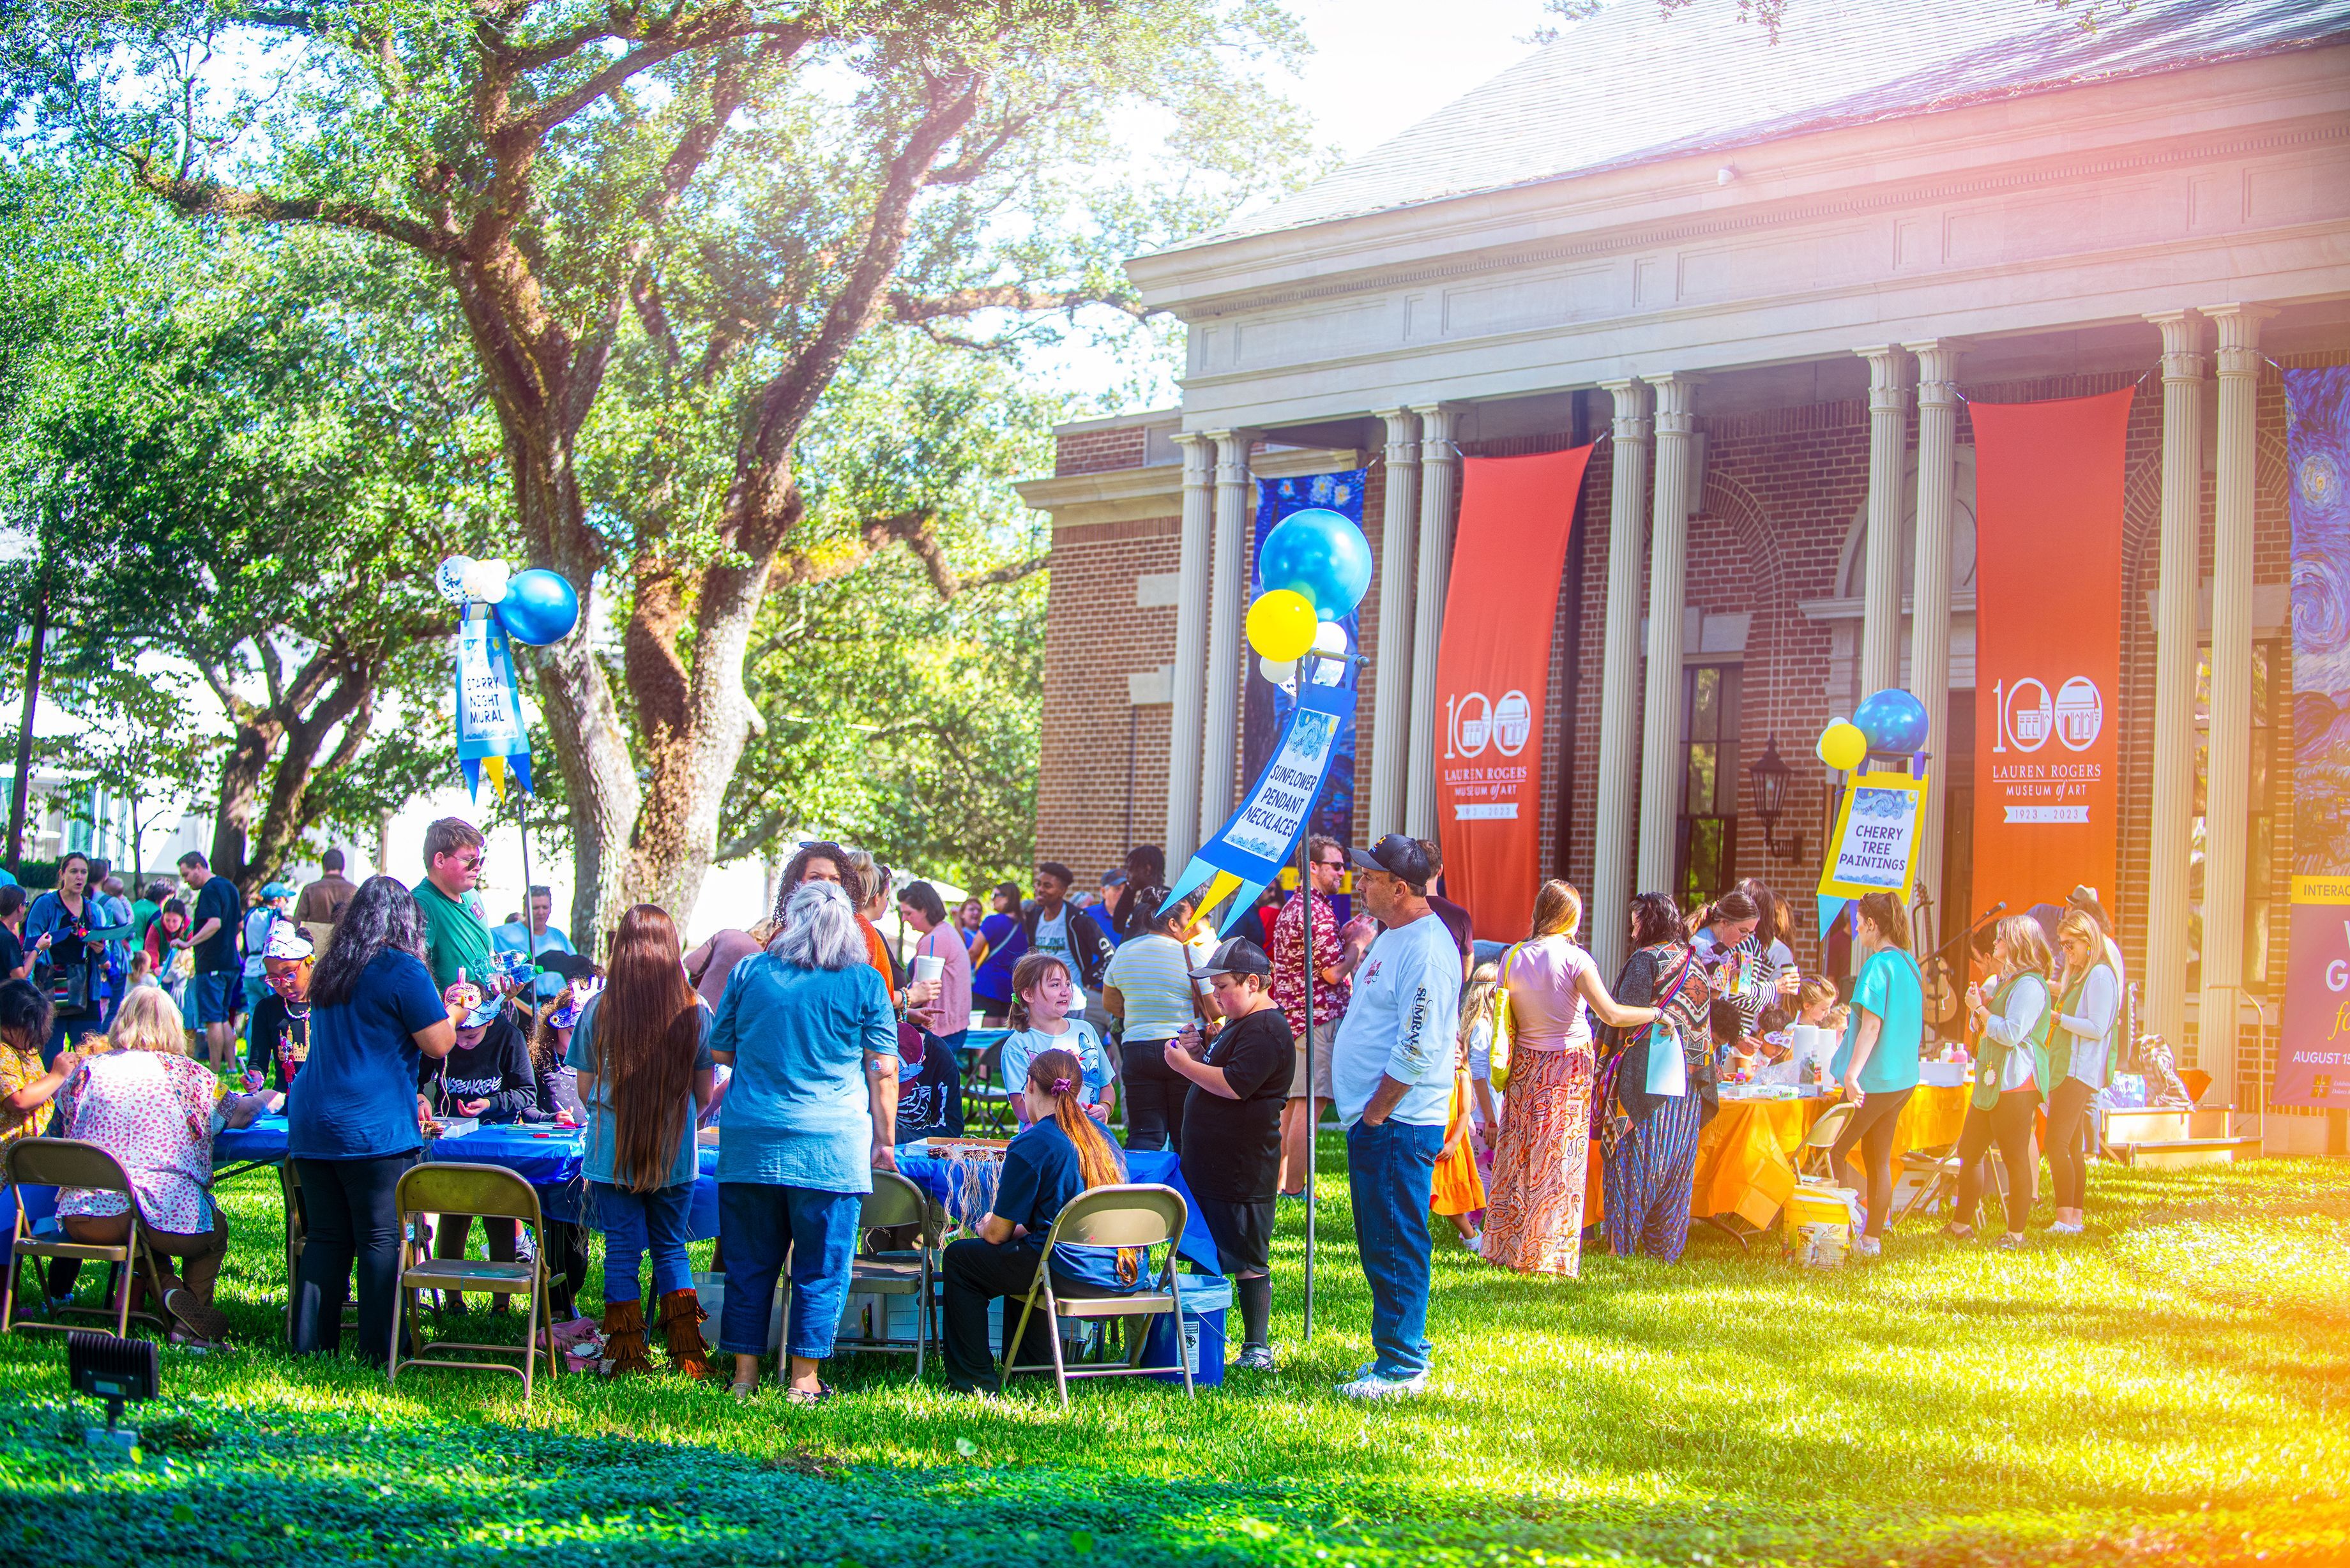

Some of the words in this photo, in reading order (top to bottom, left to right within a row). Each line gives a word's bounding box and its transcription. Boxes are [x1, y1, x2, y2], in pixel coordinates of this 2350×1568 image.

[467, 677, 499, 691] STARRY
[470, 694, 499, 708] NIGHT
[470, 709, 504, 724] MURAL
[1270, 764, 1317, 792] SUNFLOWER
[1444, 768, 1483, 782] LAUREN
[1487, 765, 1528, 780] ROGERS
[1992, 765, 2045, 778] LAUREN
[2051, 764, 2102, 778] ROGERS
[1455, 786, 1488, 796] MUSEUM
[1490, 781, 1502, 801] of
[1500, 784, 1517, 795] ART
[2006, 785, 2051, 797] MUSEUM
[2056, 778, 2070, 802] of
[2068, 784, 2086, 795] ART
[1261, 787, 1305, 814] PENDANT
[1241, 806, 1298, 837] NECKLACES
[2015, 809, 2038, 820] 1923
[2054, 808, 2078, 820] 2023
[1856, 825, 1904, 840] CHERRY
[1862, 841, 1891, 855] TREE
[1839, 853, 1906, 871] PAINTINGS
[2304, 884, 2350, 896] INTERAC
[2293, 1051, 2341, 1064] AUGUST
